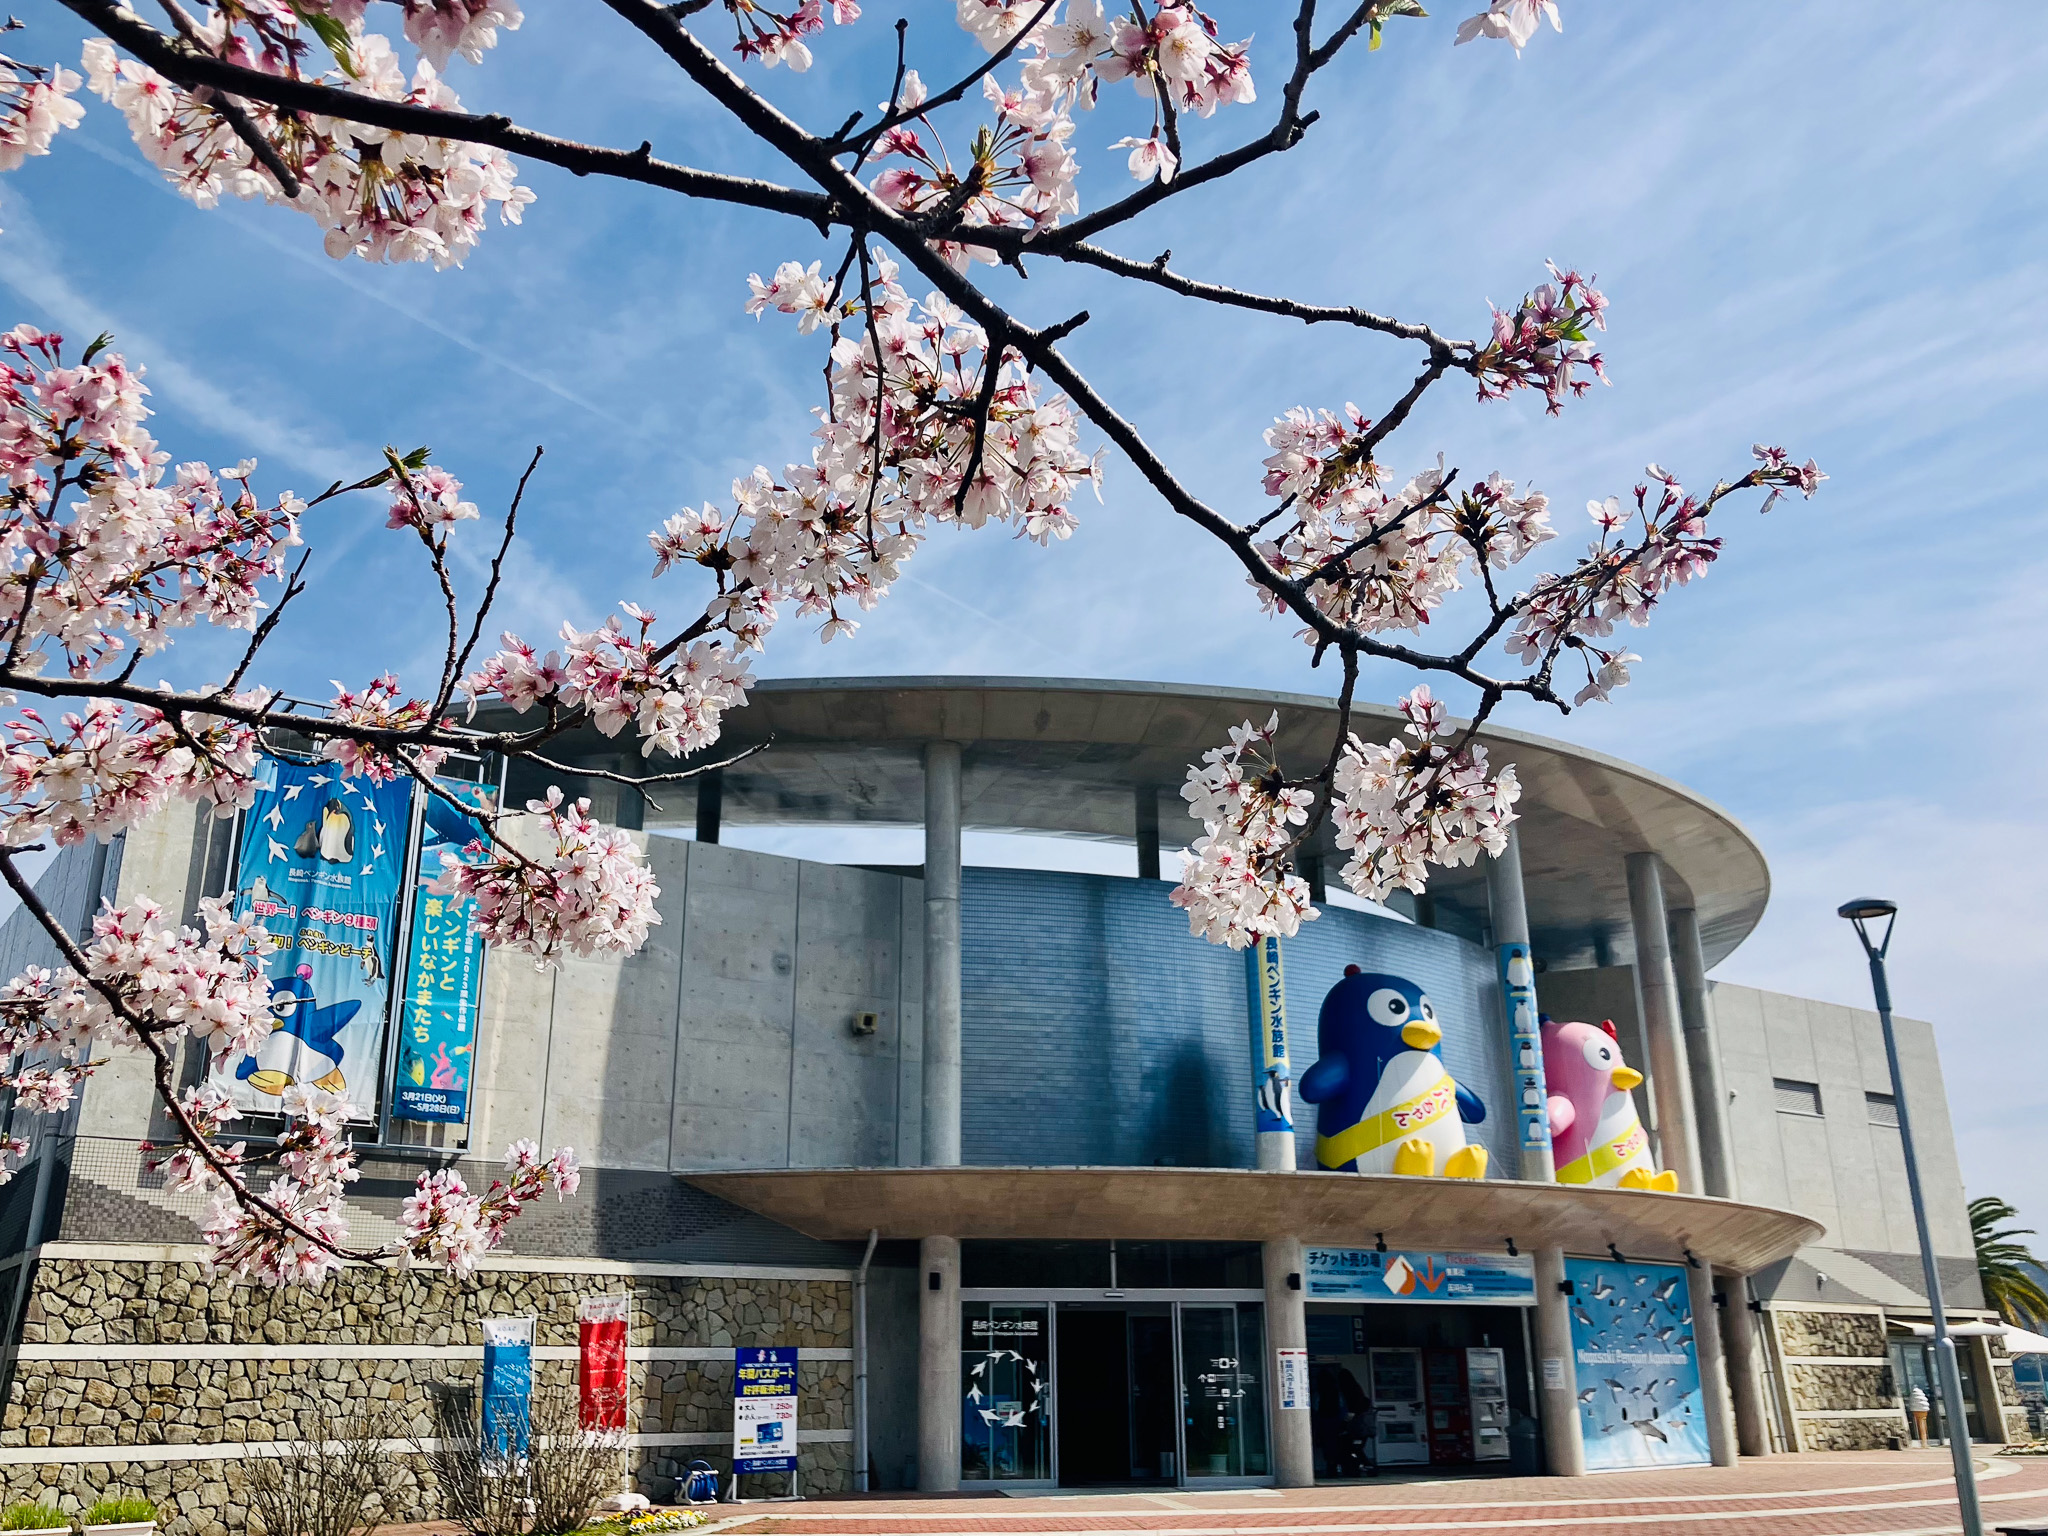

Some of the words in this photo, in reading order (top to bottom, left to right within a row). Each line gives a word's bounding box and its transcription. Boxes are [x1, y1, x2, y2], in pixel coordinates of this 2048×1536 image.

[289, 867, 352, 886] 長崎ペンギン水族館
[301, 907, 378, 931] ペンギン9種類
[299, 937, 373, 959] ペンギンビーチ
[413, 897, 443, 1043] 楽しいなかまたち
[1309, 1252, 1381, 1267] チケット売り場
